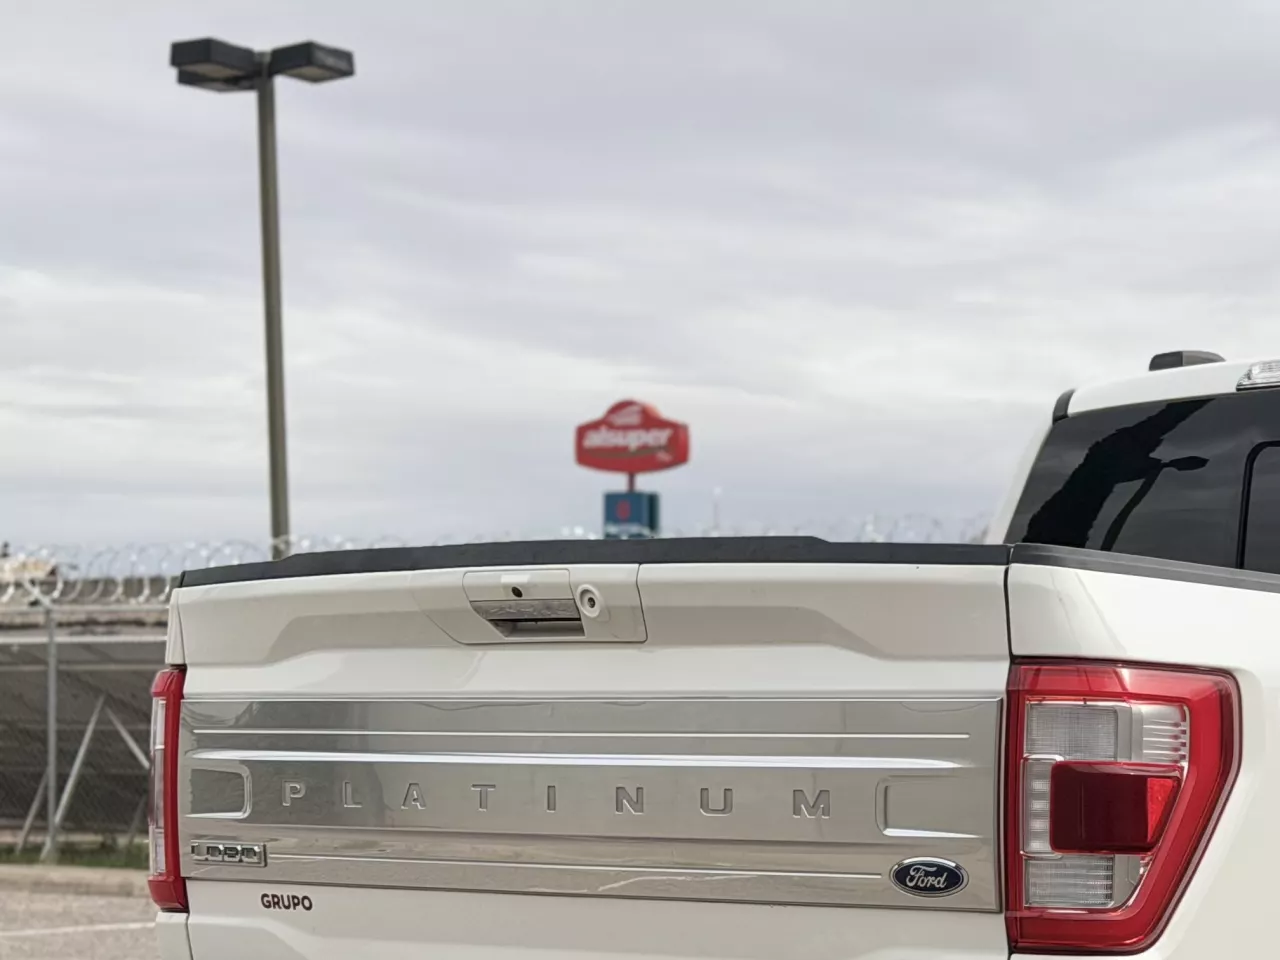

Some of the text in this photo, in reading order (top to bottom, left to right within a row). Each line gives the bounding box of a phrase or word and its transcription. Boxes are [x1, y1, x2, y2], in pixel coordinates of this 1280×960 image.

[281, 779, 831, 819] PLATINUM
[905, 864, 948, 888] Ford
[260, 893, 313, 911] GRUPO
